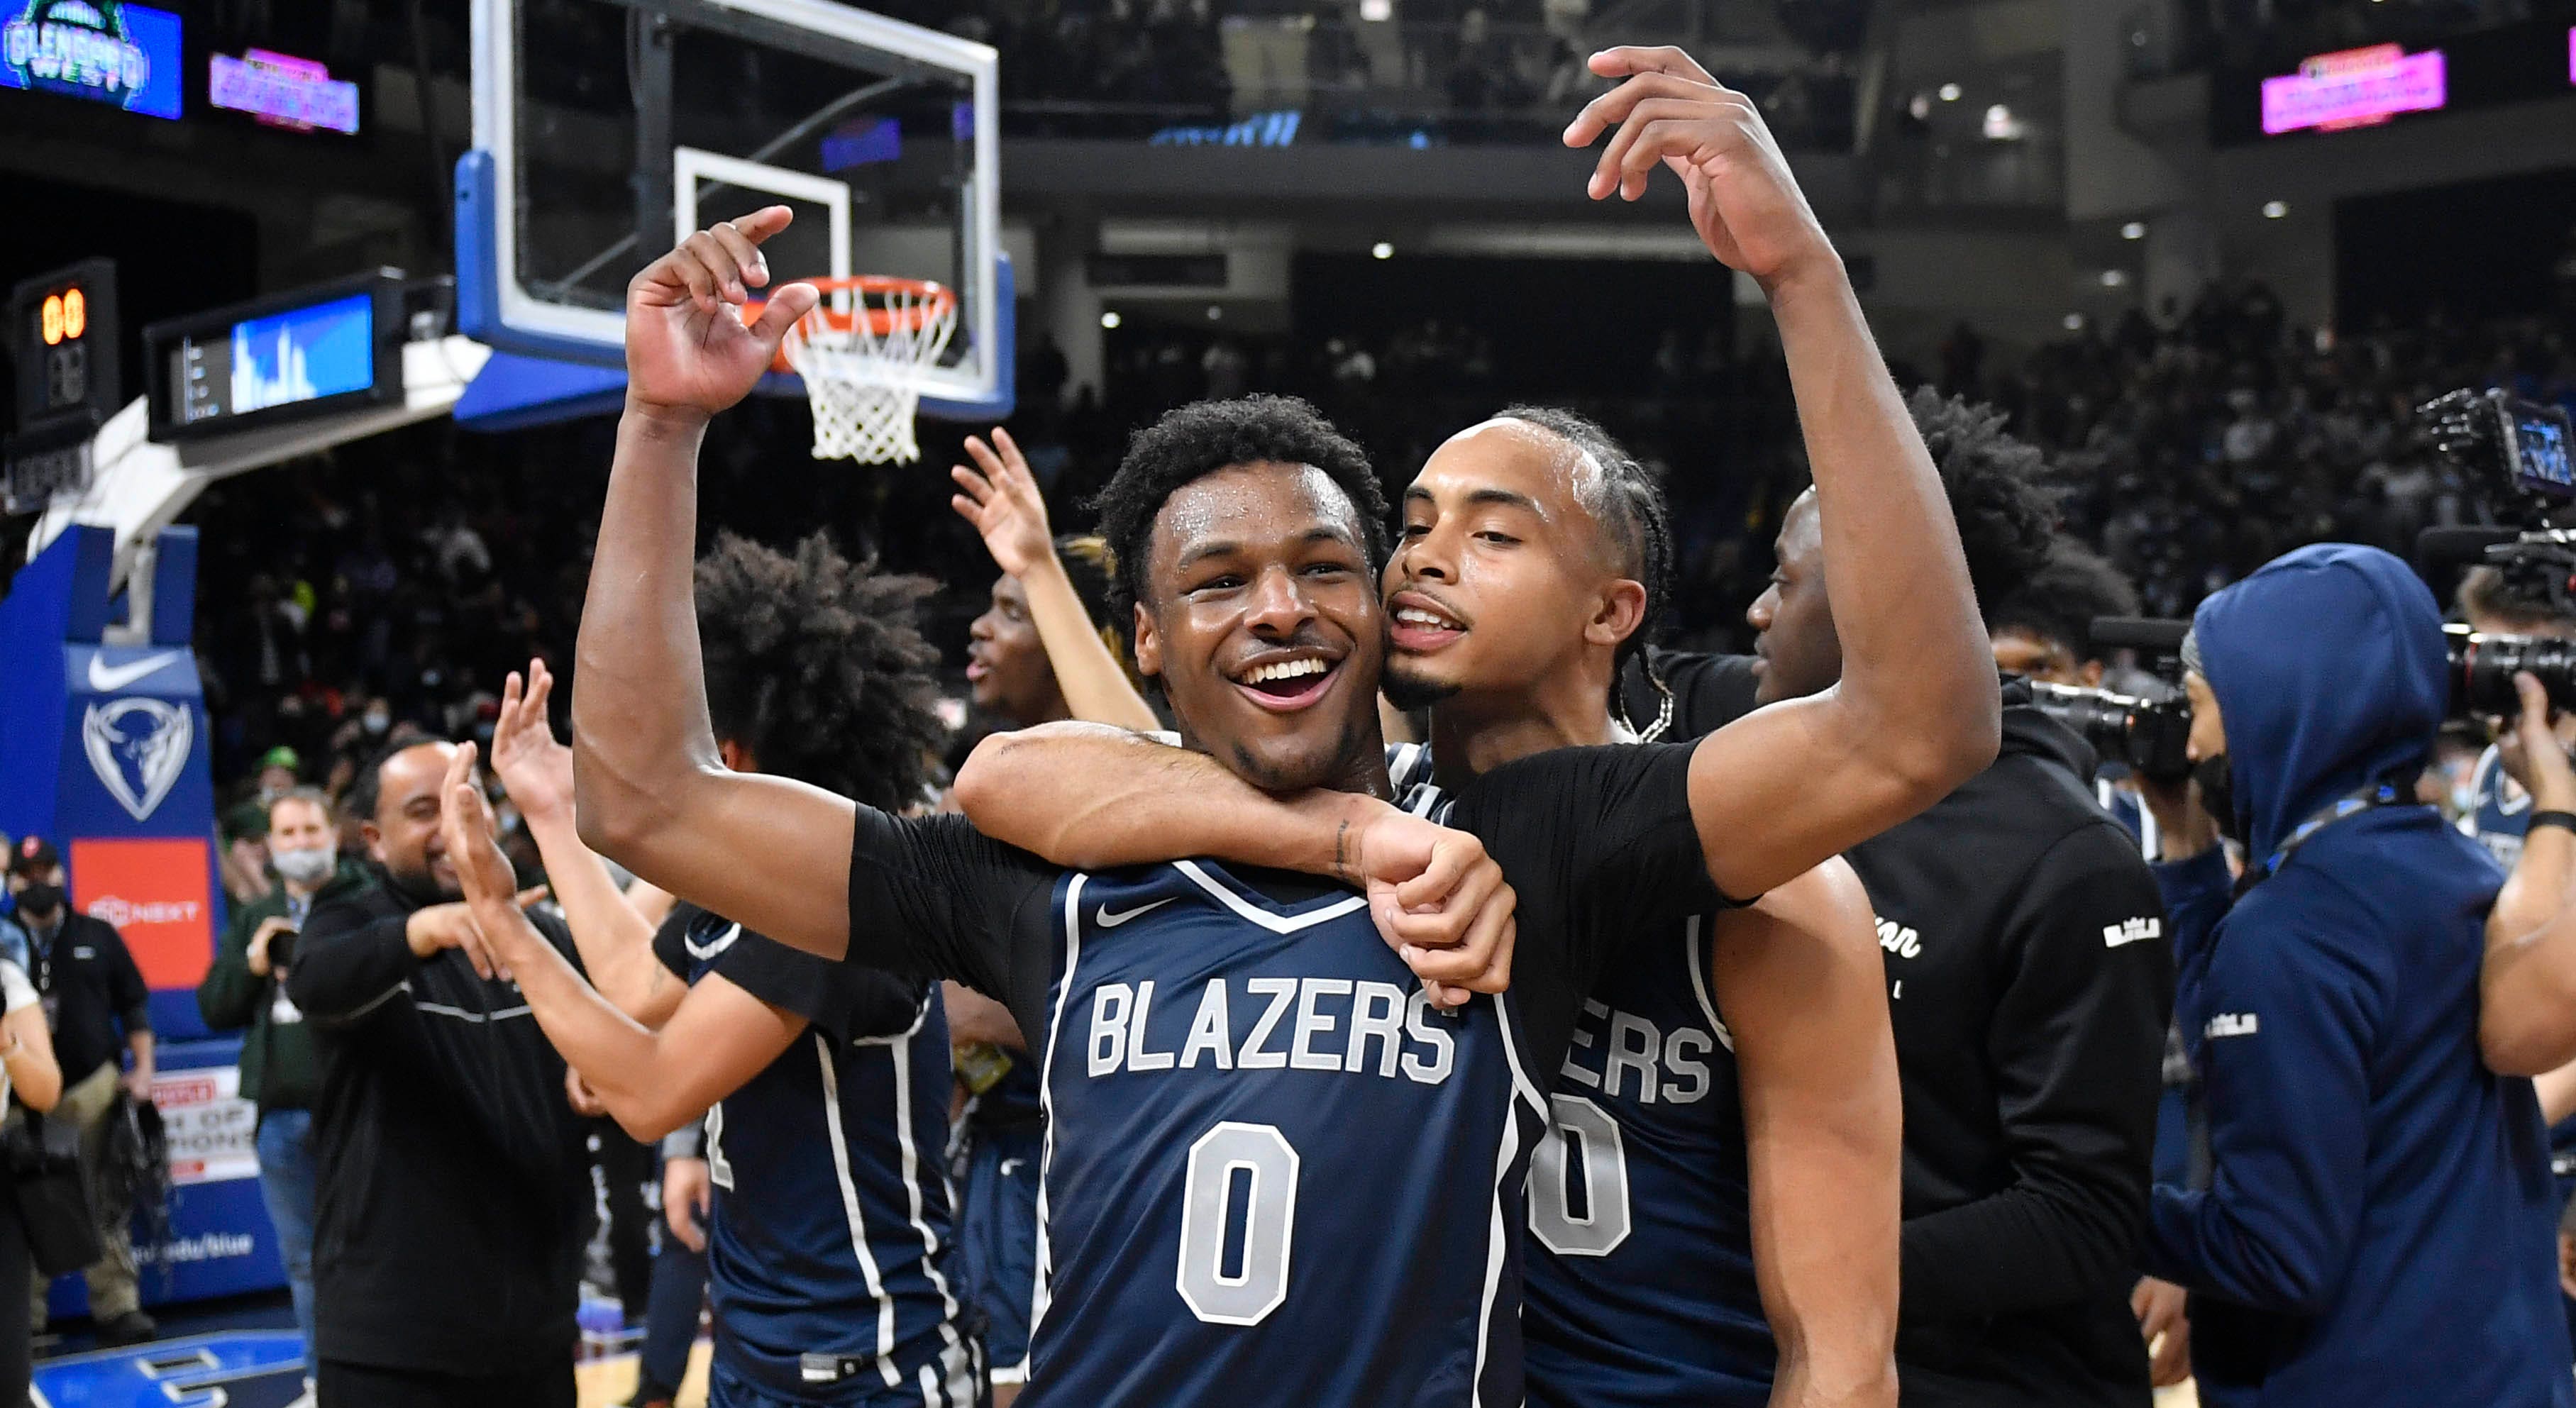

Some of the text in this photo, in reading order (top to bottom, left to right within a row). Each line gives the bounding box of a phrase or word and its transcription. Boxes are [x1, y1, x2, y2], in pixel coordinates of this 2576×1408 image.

[1088, 977, 1456, 1086] BLAZERS
[1559, 996, 1713, 1105] ERS
[1176, 1121, 1300, 1326] 0
